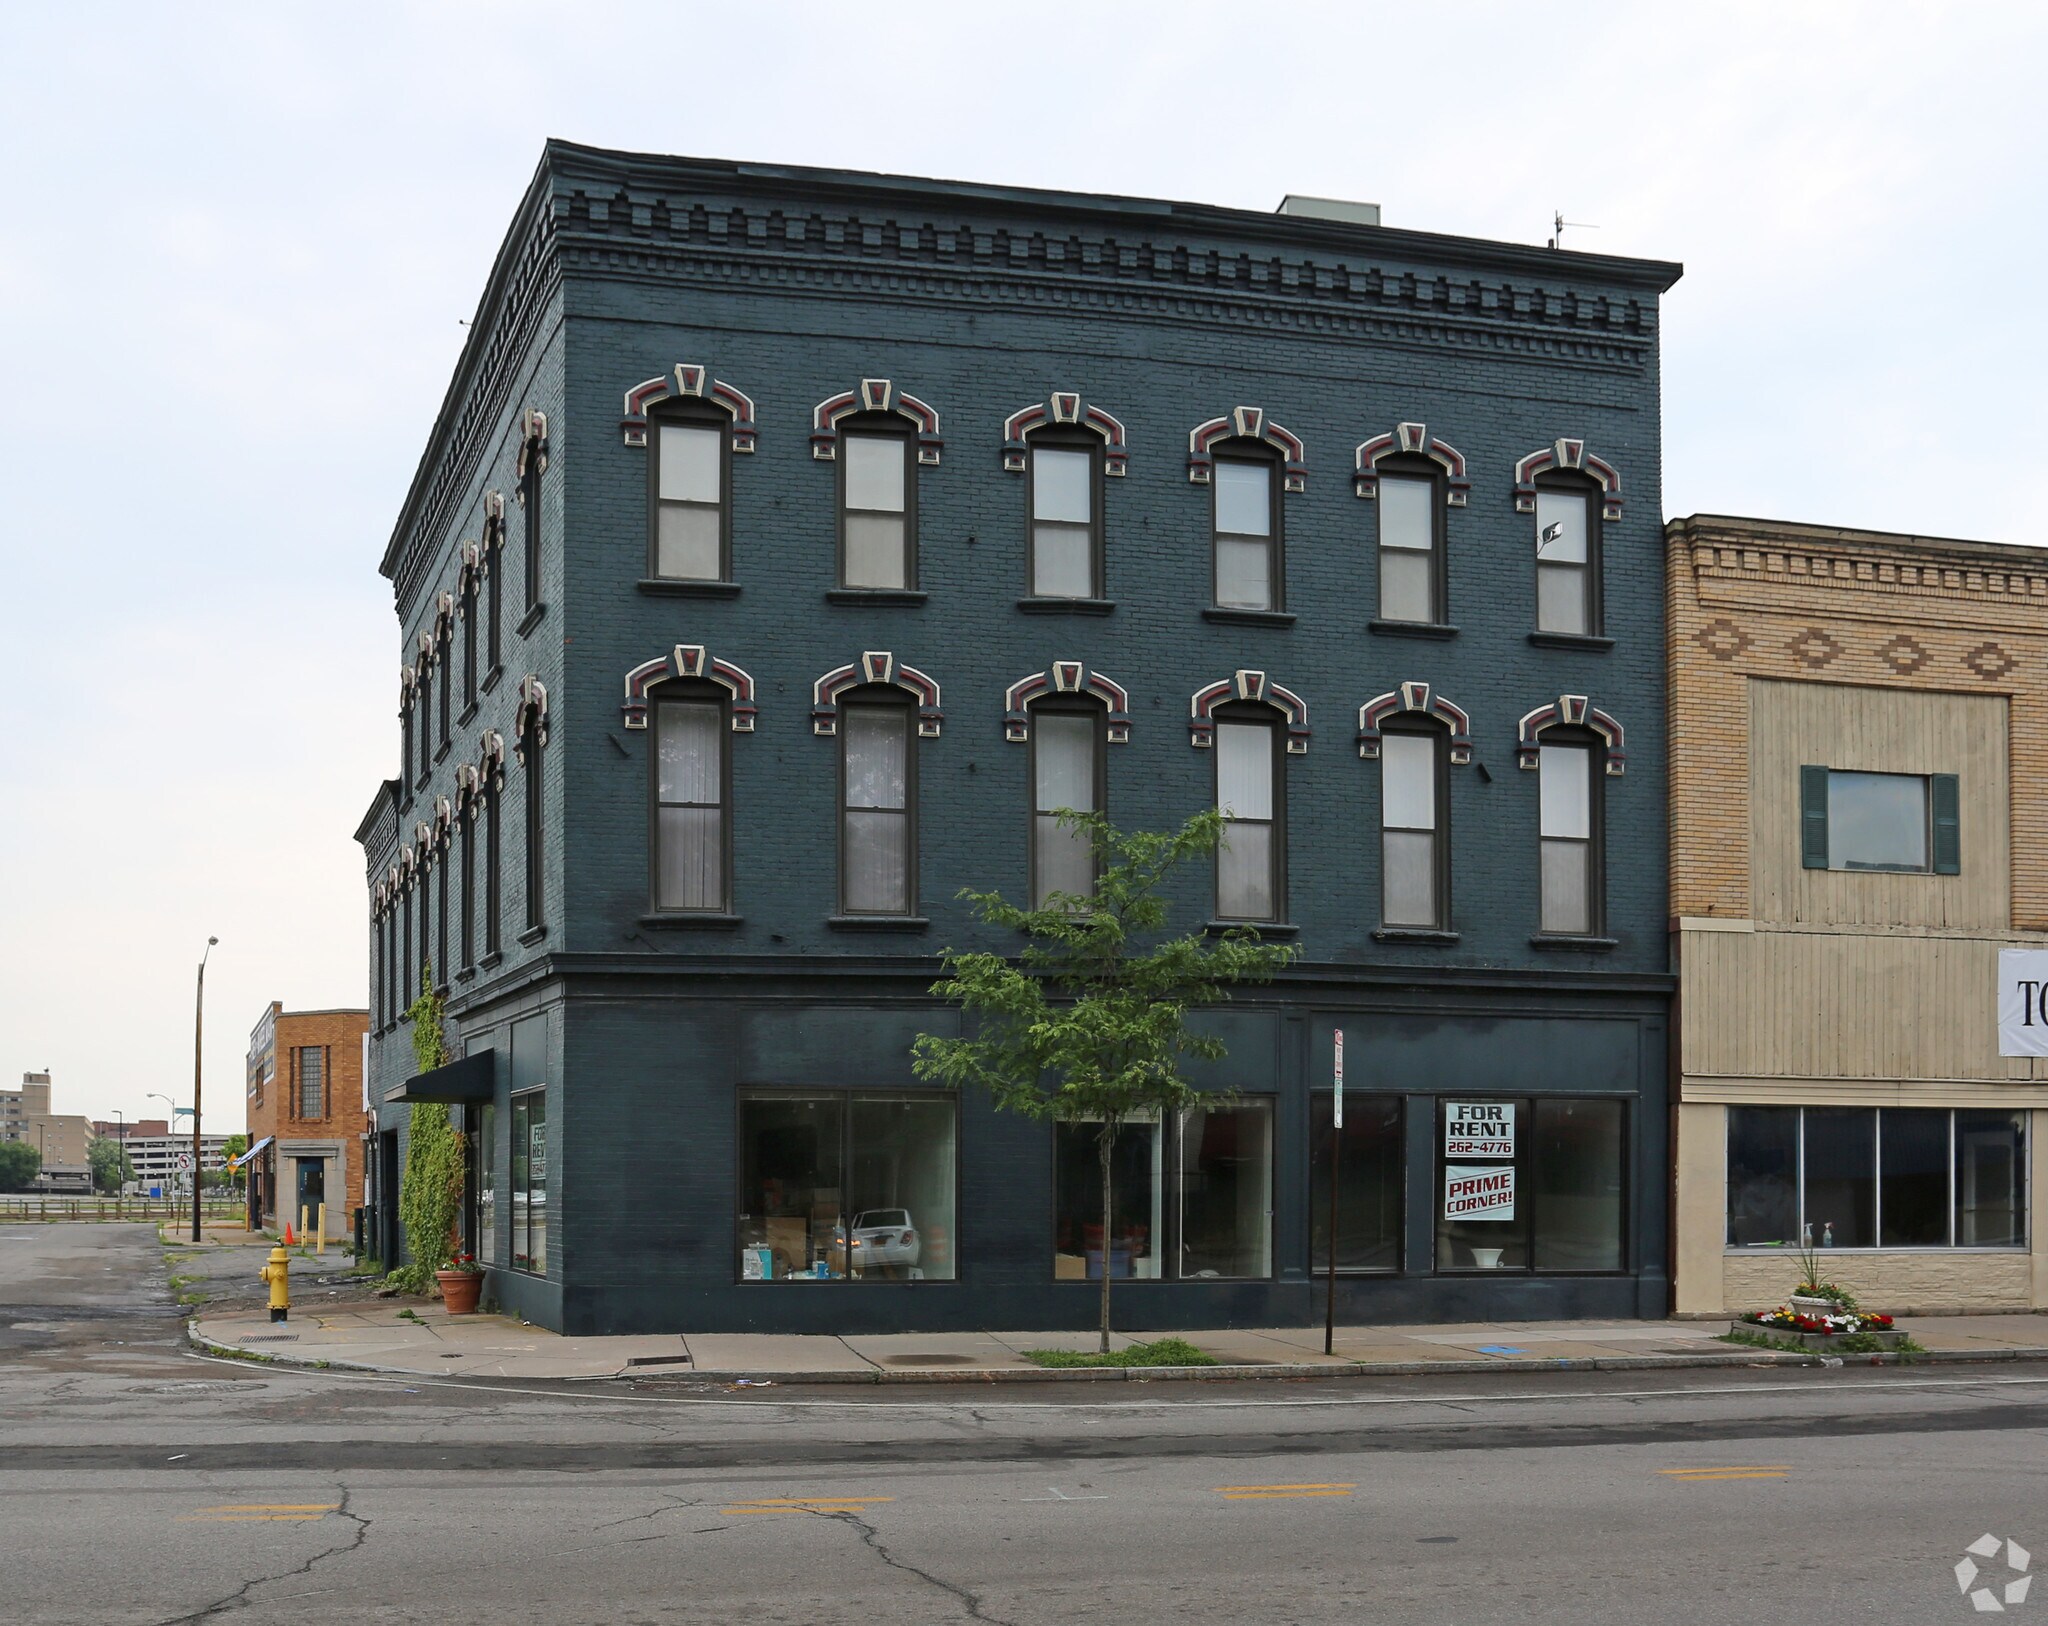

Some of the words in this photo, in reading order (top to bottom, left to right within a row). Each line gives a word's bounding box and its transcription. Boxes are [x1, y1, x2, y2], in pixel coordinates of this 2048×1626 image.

[1457, 1105, 1503, 1121] FOR
[1449, 1121, 1511, 1137] RENT
[1448, 1141, 1512, 1153] 262-4776
[1449, 1173, 1511, 1199] PRIME
[1447, 1191, 1512, 1214] CORNER!
